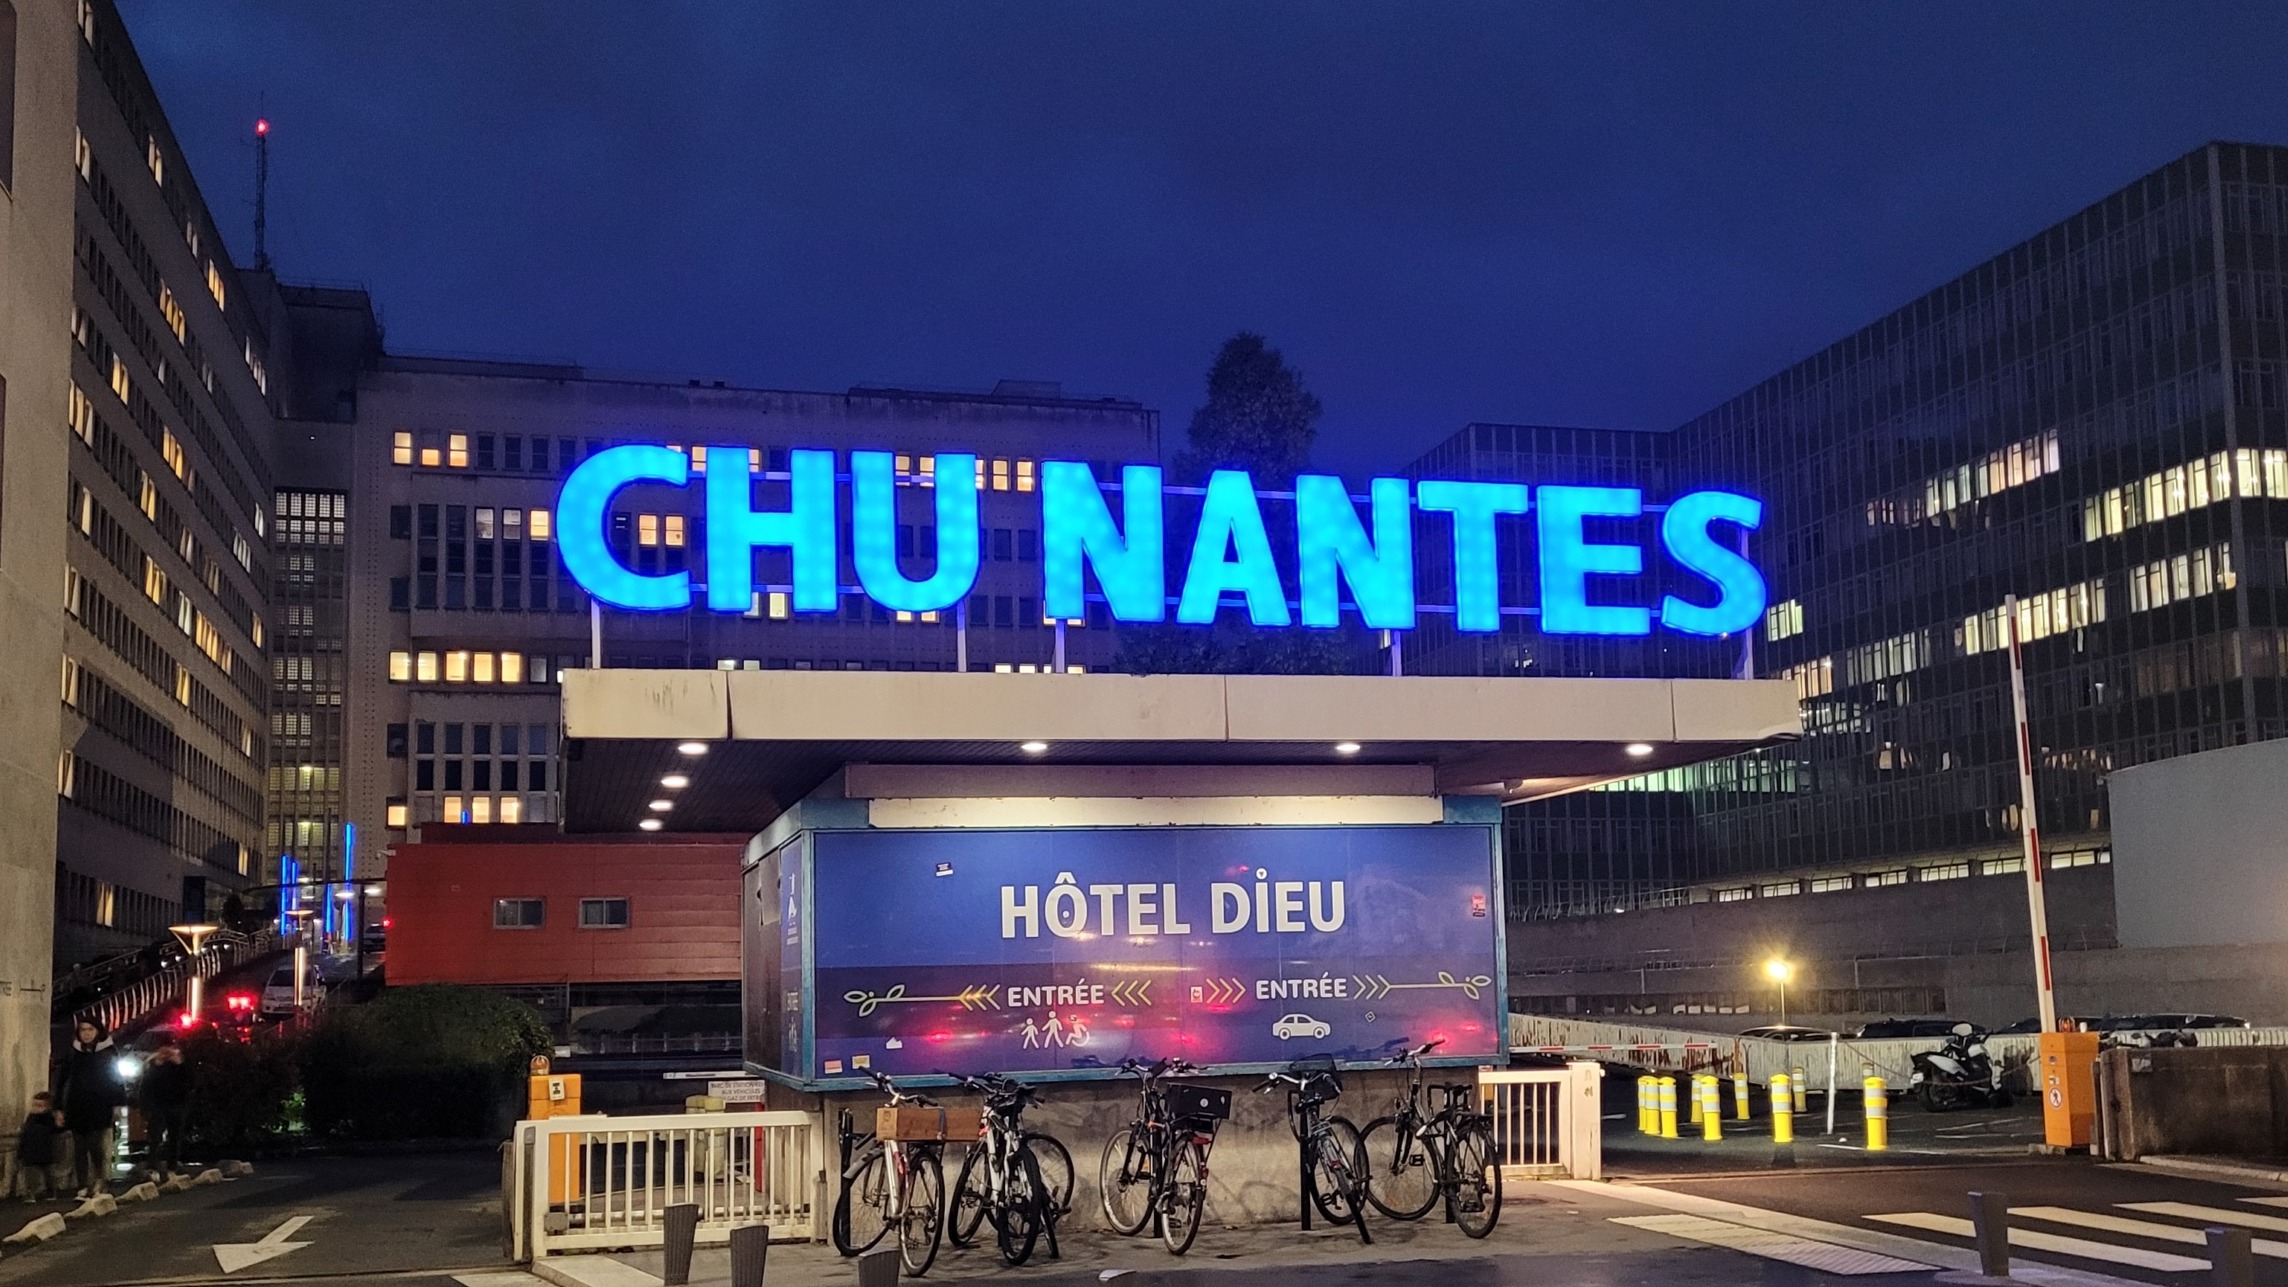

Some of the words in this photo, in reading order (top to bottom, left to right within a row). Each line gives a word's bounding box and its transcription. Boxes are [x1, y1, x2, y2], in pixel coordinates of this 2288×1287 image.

[555, 443, 980, 614] CHU
[1041, 459, 1767, 637] NANTES
[1001, 872, 1191, 939] HÔTEL
[1211, 877, 1346, 934] DIEU
[1007, 978, 1105, 1008] ENTRÉE
[1256, 971, 1348, 1000] ENTRÉE
